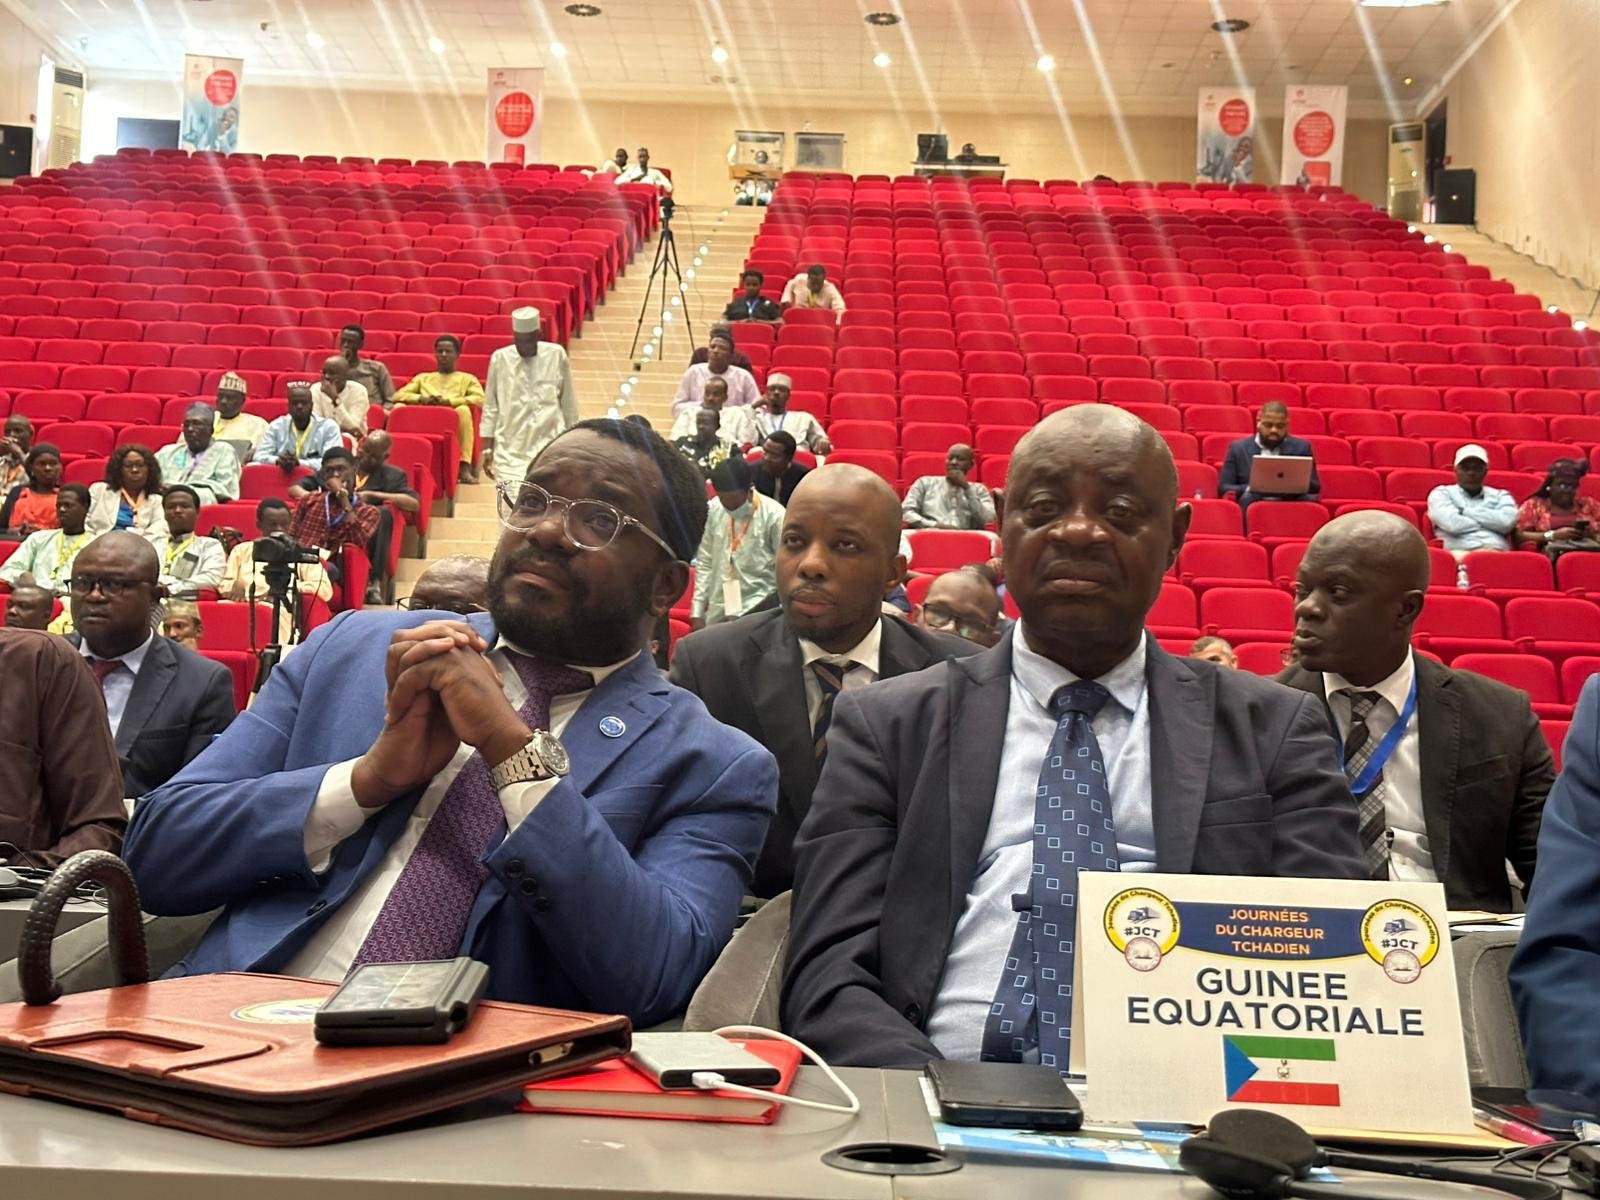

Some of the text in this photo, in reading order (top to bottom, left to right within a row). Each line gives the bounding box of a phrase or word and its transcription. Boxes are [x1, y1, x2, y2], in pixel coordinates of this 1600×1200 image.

[1229, 908, 1309, 923] JOURNÉES
[1124, 926, 1160, 938] #JCT
[1215, 924, 1324, 939] DU CHARGEUR
[1232, 941, 1310, 955] TCHADIEN
[1381, 938, 1418, 950] #JCT
[1196, 967, 1348, 1000] GUINEE
[1128, 996, 1424, 1036] EQUATORIALE
